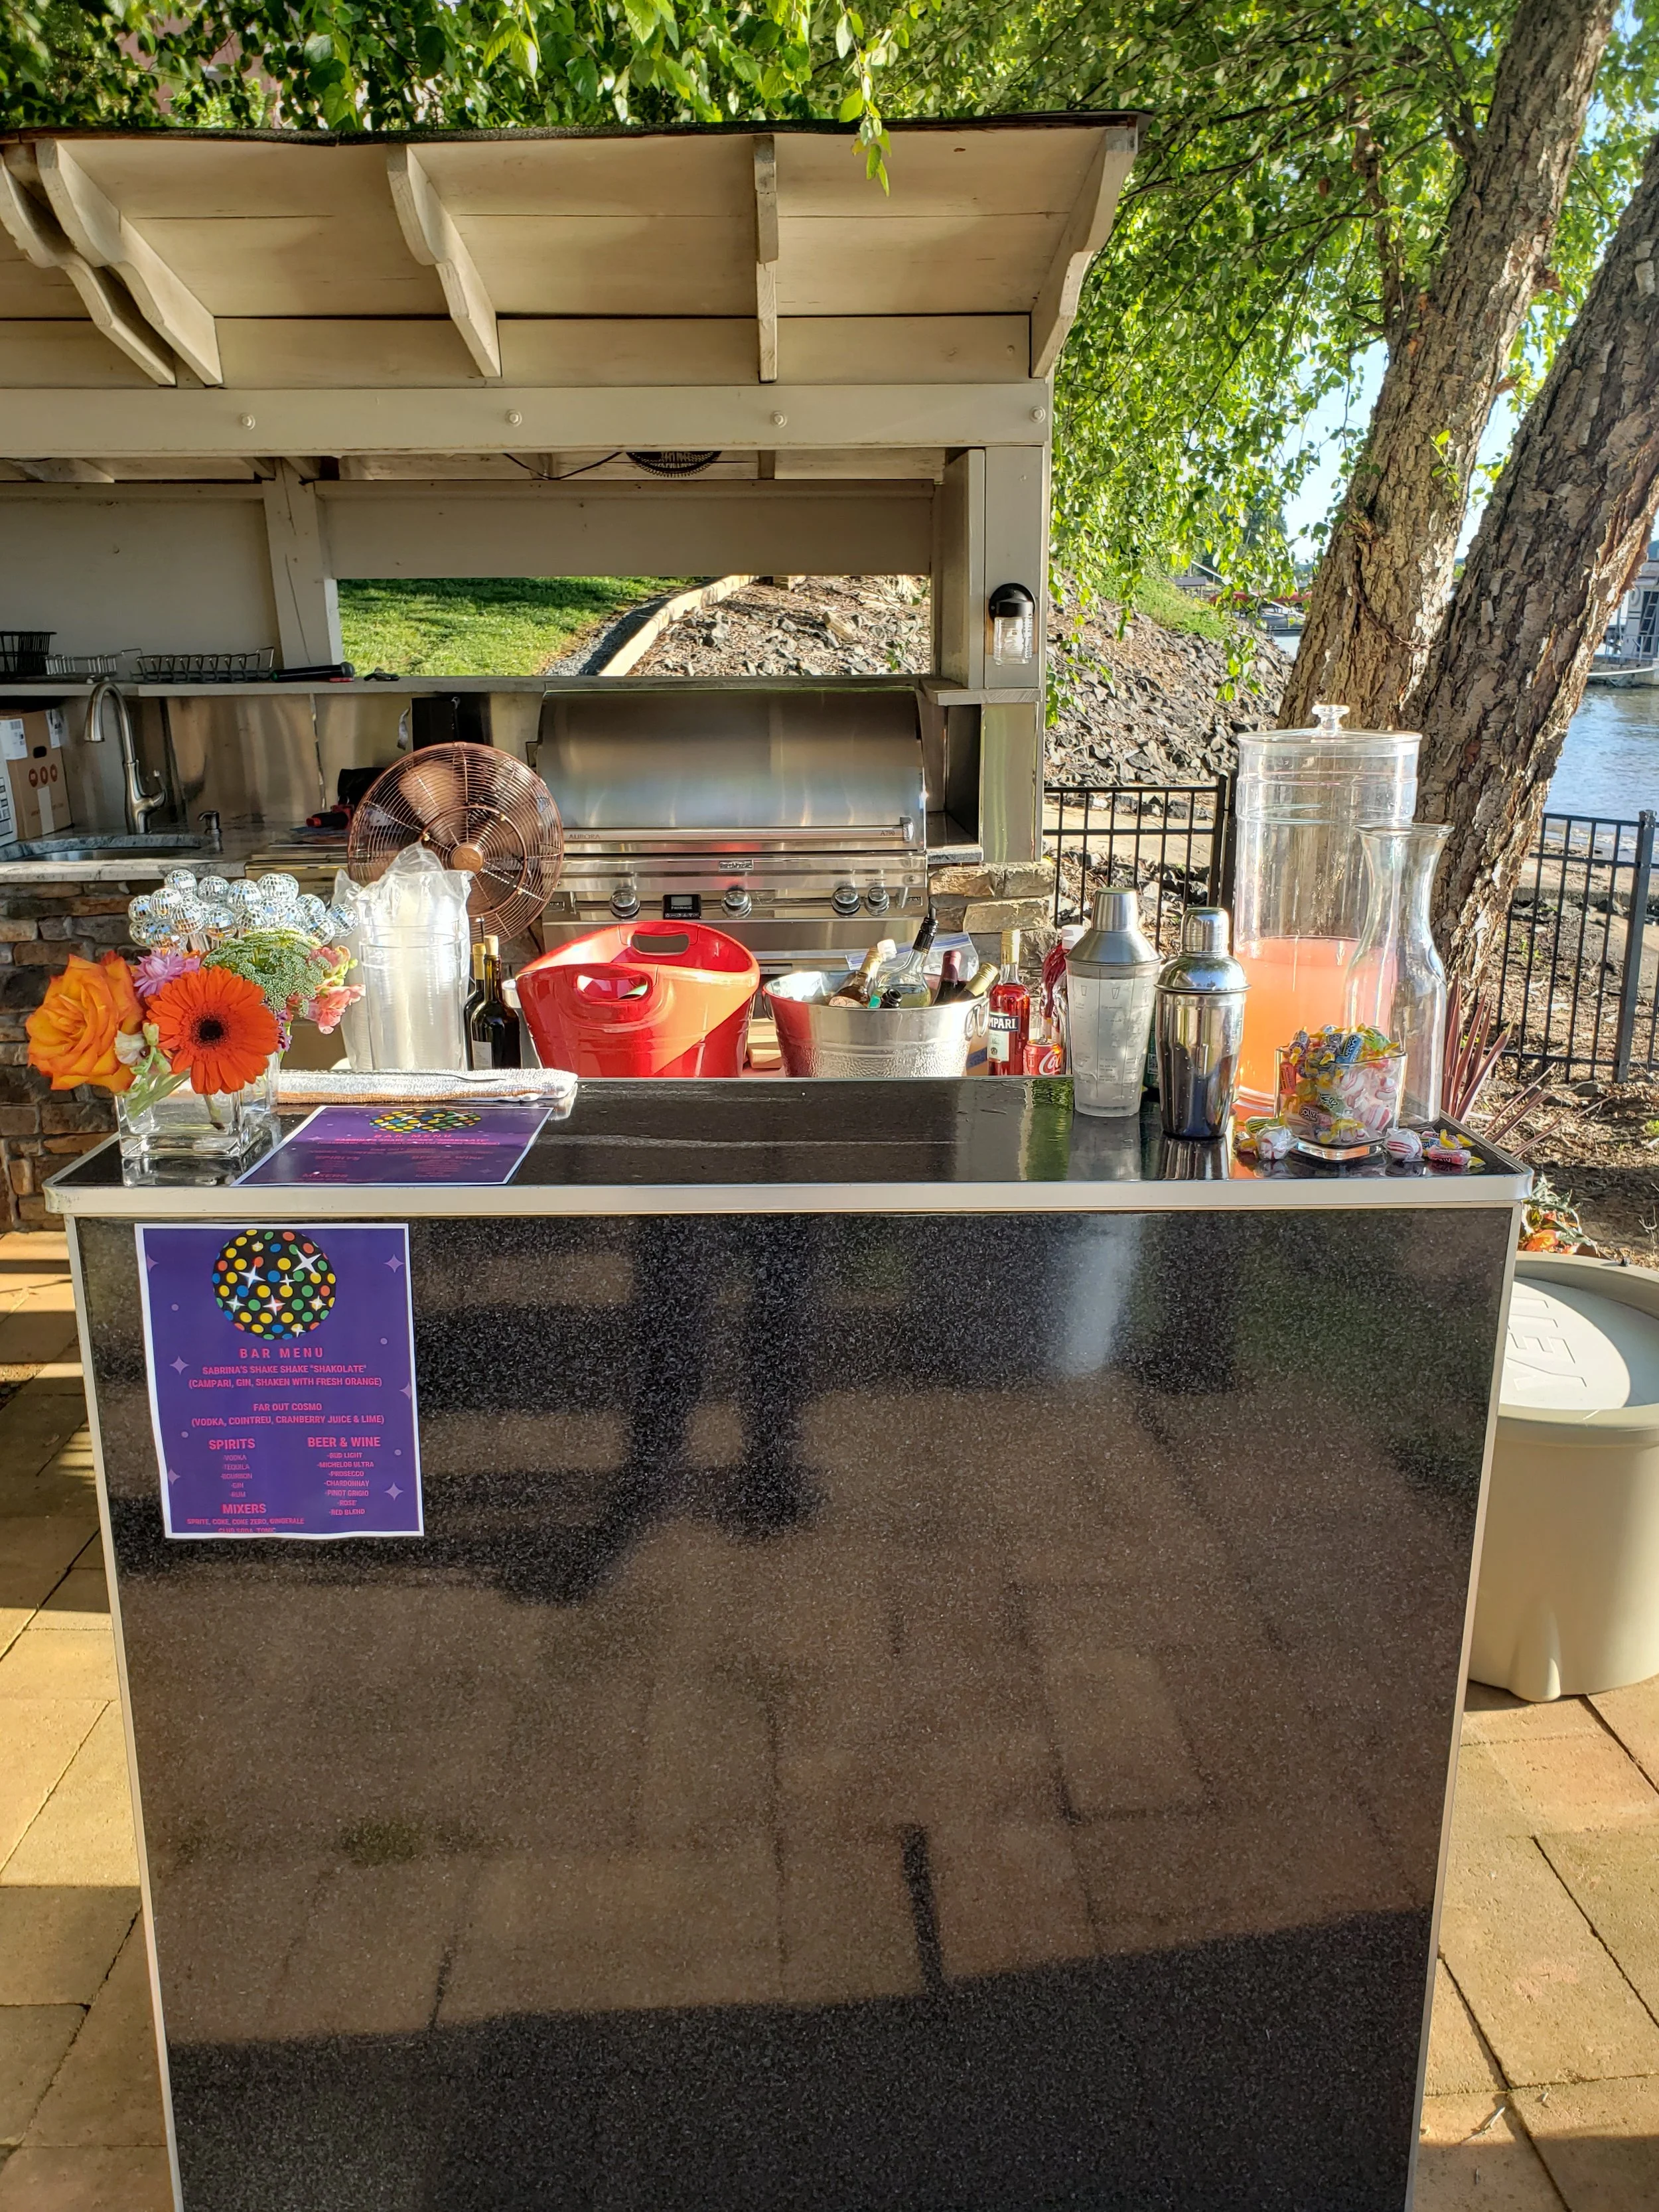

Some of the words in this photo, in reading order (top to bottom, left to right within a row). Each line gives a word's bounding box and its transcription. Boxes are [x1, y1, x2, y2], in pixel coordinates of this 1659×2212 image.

[989, 1016, 1016, 1029] MPARI
[240, 1349, 271, 1359] BAR
[279, 1347, 323, 1358] MENU
[202, 1365, 248, 1375] SABRINA'S
[250, 1364, 279, 1374] SHAKE
[280, 1364, 309, 1373] SHAKE
[310, 1364, 367, 1373] "SHAKOLATE"
[188, 1379, 234, 1389] (CAMPARI,
[236, 1379, 253, 1388] GIN,
[316, 1377, 343, 1386] FRESH
[345, 1376, 382, 1386] ORANGE)
[253, 1403, 270, 1412] FAR
[291, 1402, 323, 1411] COSMO
[192, 1418, 227, 1428] (VODKA,
[228, 1416, 274, 1426] COINTREU,
[275, 1416, 325, 1424] CRANBERRY
[327, 1415, 352, 1424] JUICE
[361, 1414, 385, 1424] LIME)
[208, 1438, 256, 1450] SPIRITS
[307, 1436, 337, 1447] BEER
[339, 1436, 348, 1447] &
[350, 1436, 381, 1447] WINE
[222, 1503, 267, 1514] MIXERS
